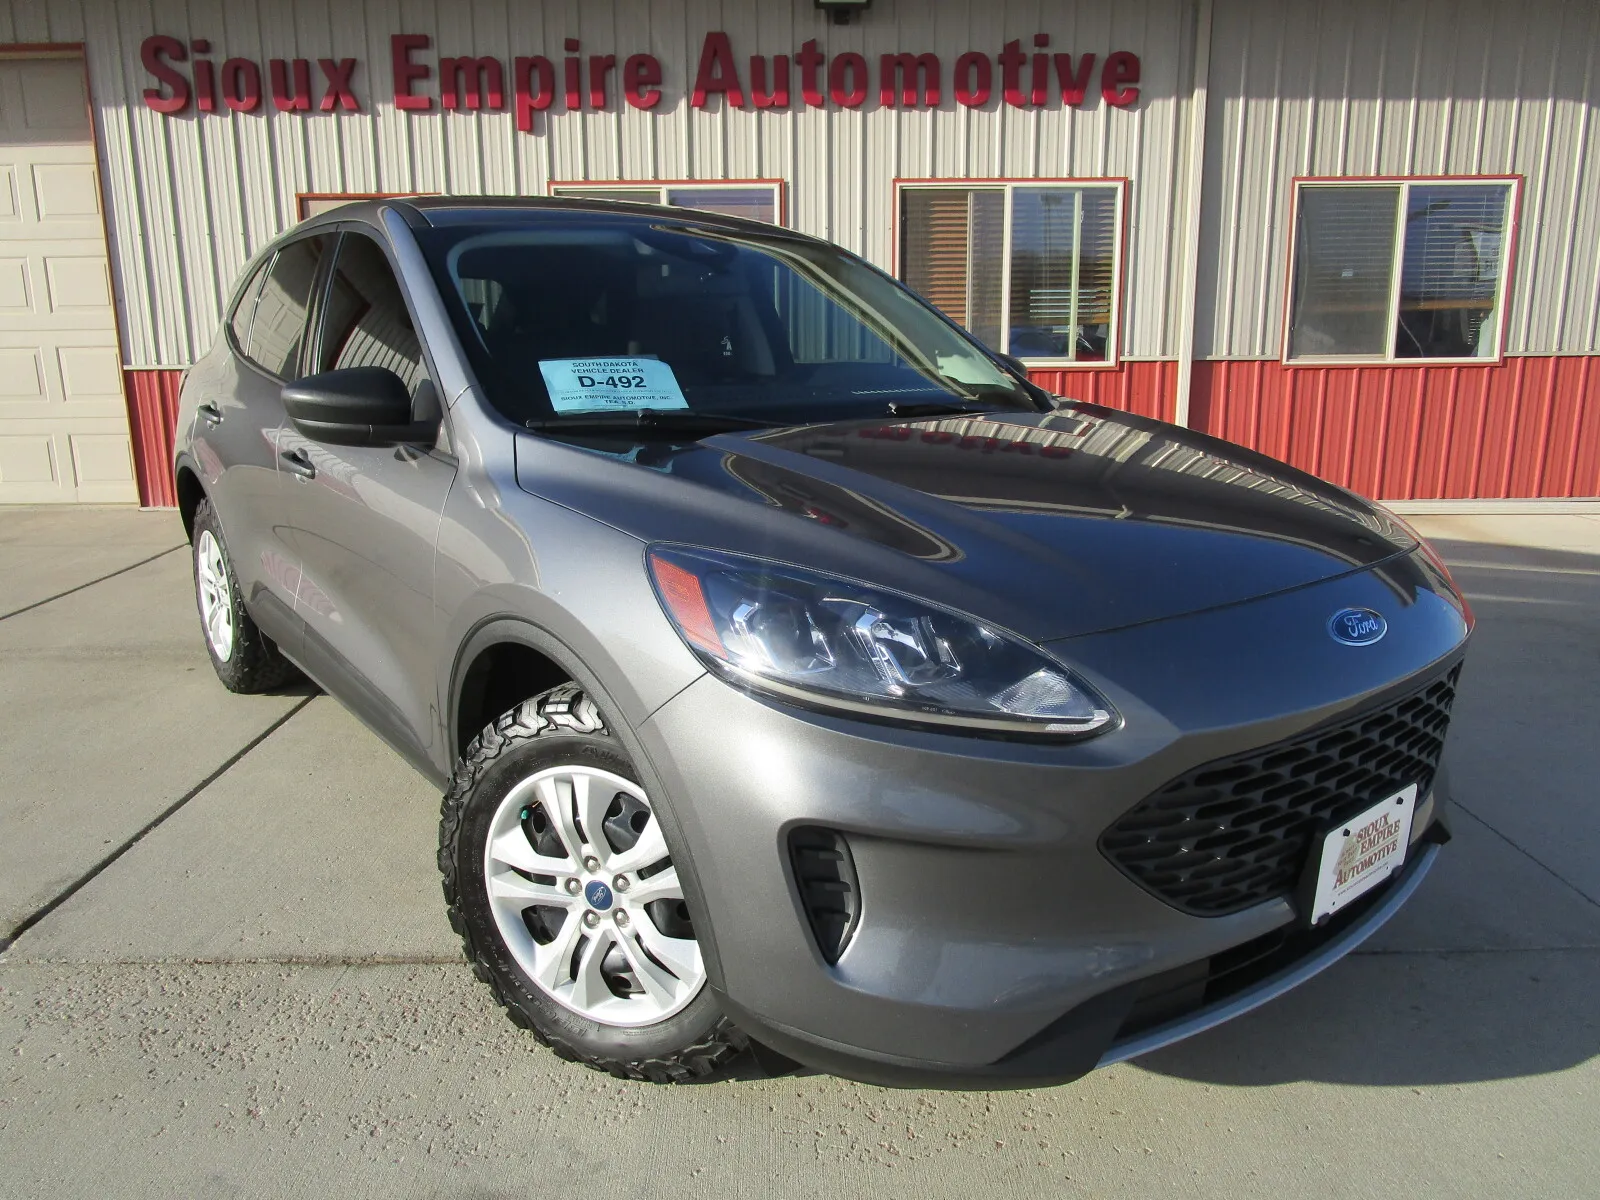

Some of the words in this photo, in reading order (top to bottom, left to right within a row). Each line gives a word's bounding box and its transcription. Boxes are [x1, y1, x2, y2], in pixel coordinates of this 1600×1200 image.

[140, 34, 360, 115] Sioux
[391, 34, 662, 132] Empire
[691, 31, 1141, 109] Automotive
[577, 375, 647, 389] D-492
[1343, 613, 1379, 638] Ford
[1356, 812, 1390, 843] SIOUX
[1360, 818, 1401, 856] EMPIRE
[1332, 839, 1398, 890] AUTOMOTIVE
